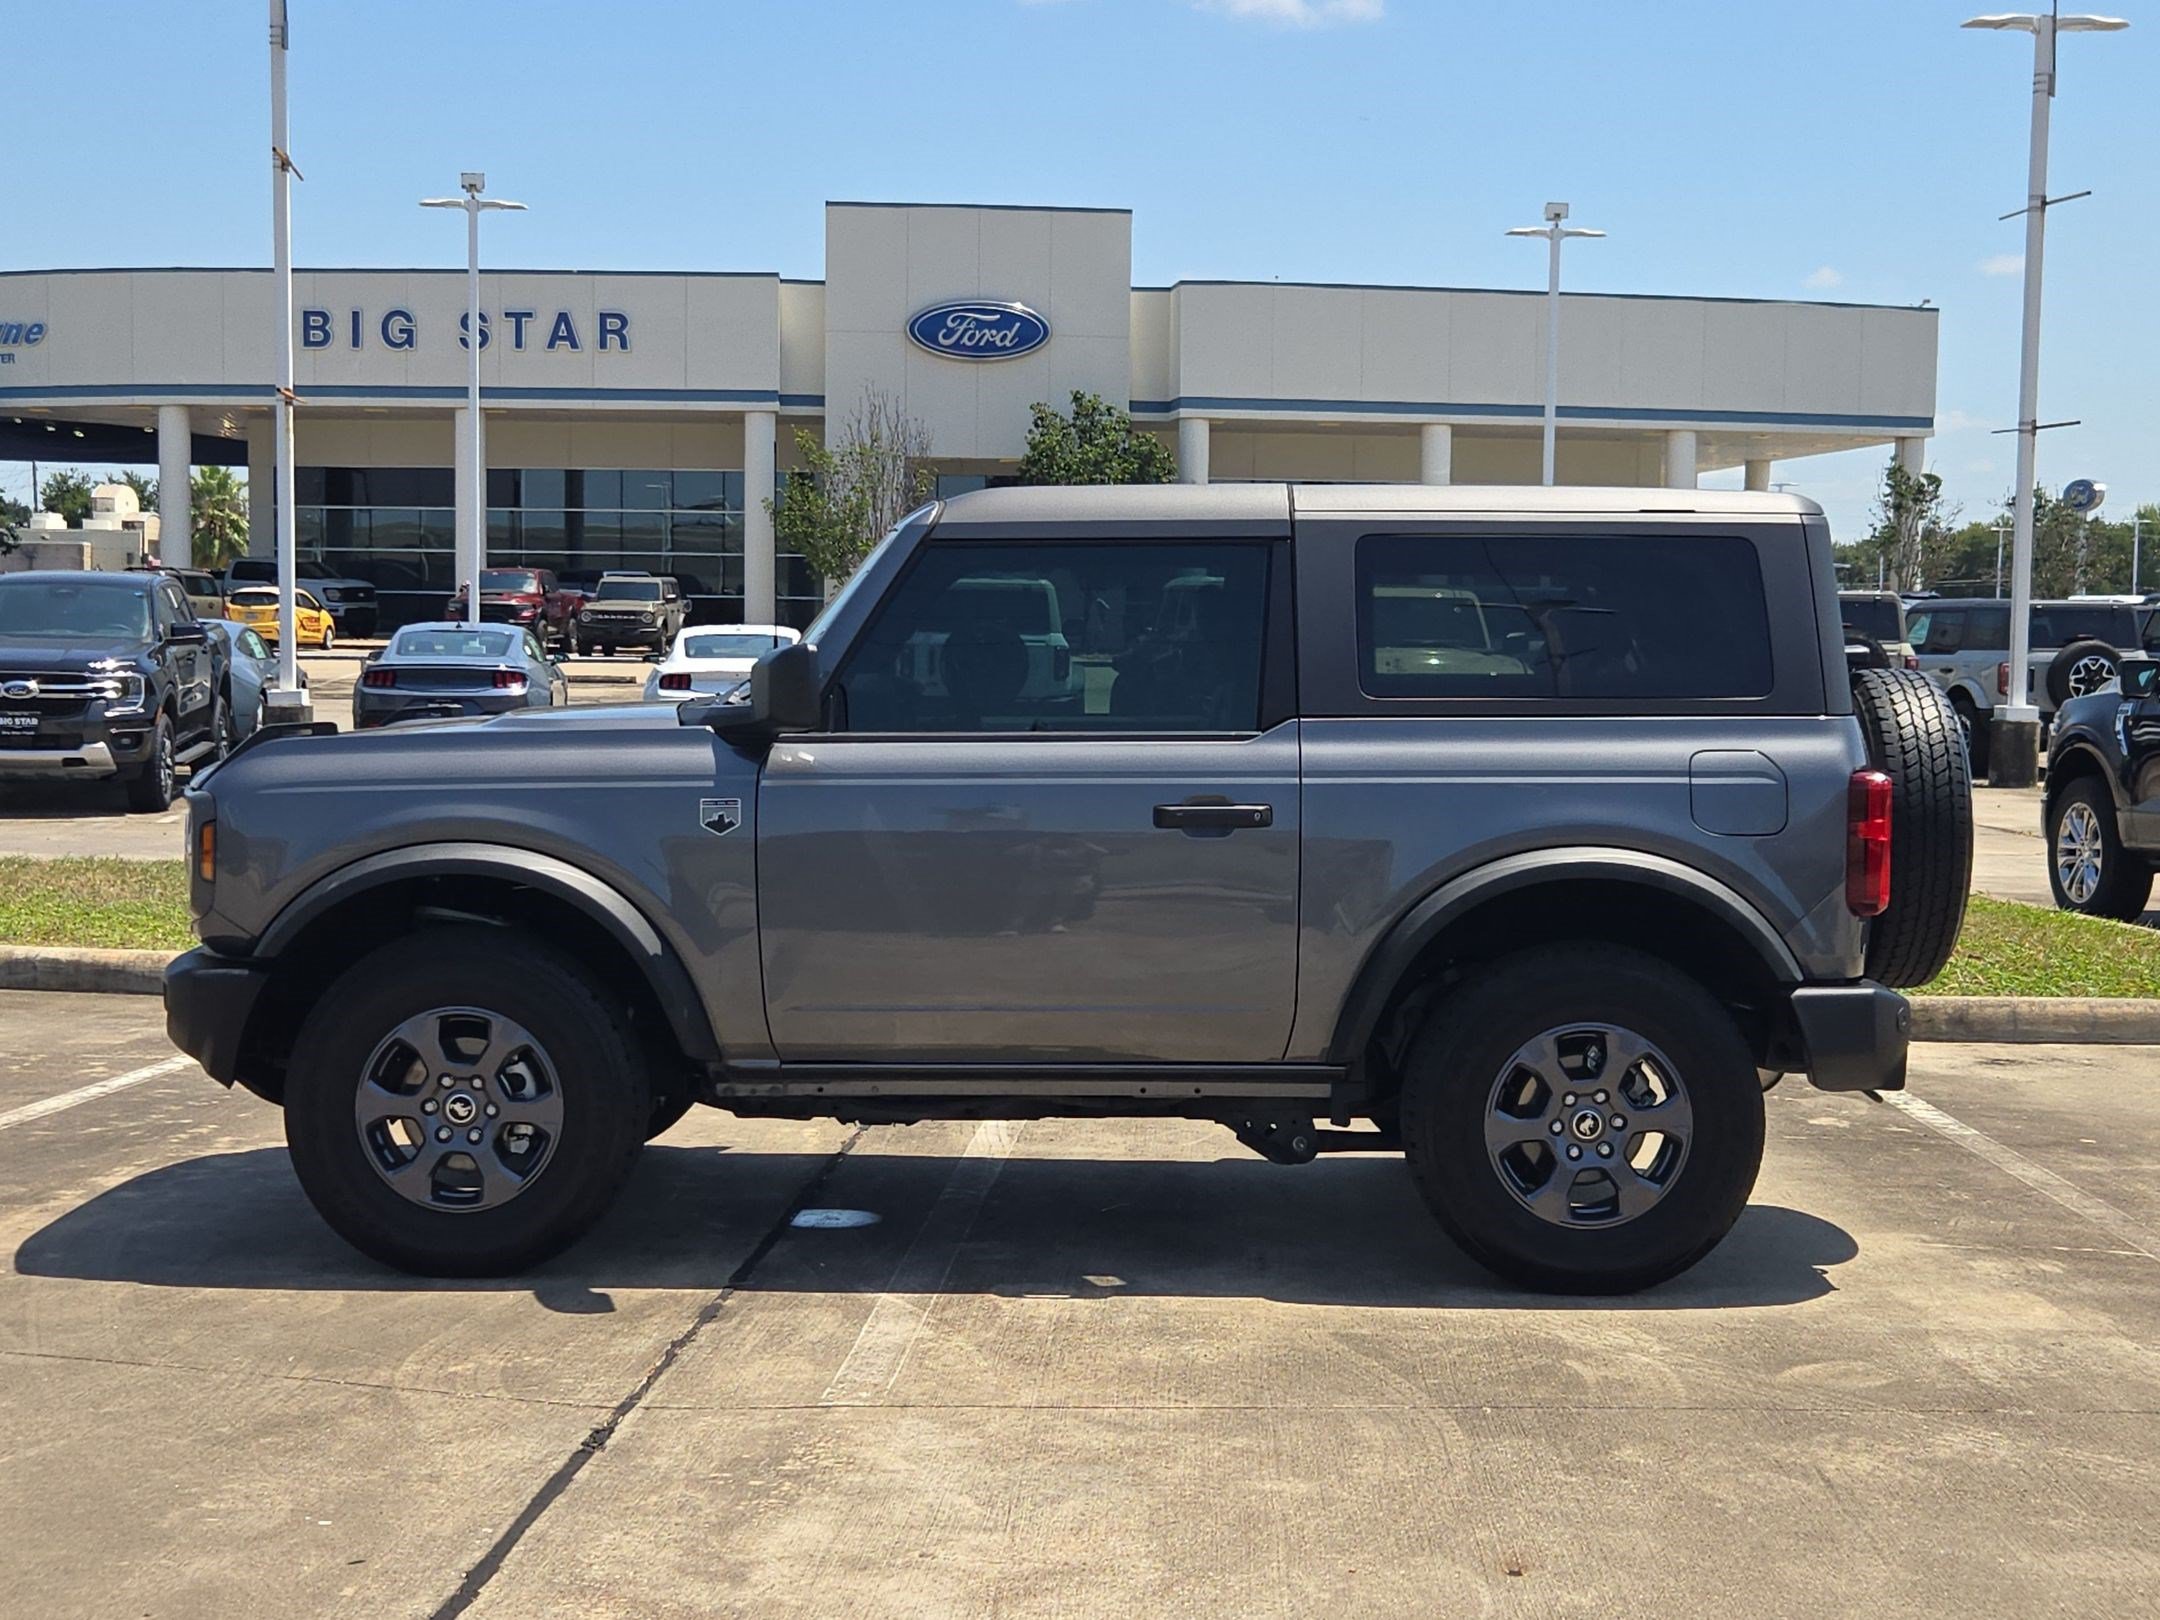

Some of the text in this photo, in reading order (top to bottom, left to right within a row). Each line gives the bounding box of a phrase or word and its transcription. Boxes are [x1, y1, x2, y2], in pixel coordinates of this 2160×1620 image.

[0, 321, 46, 346] ne
[301, 308, 632, 353] BIG STAR
[937, 312, 1021, 348] Ford
